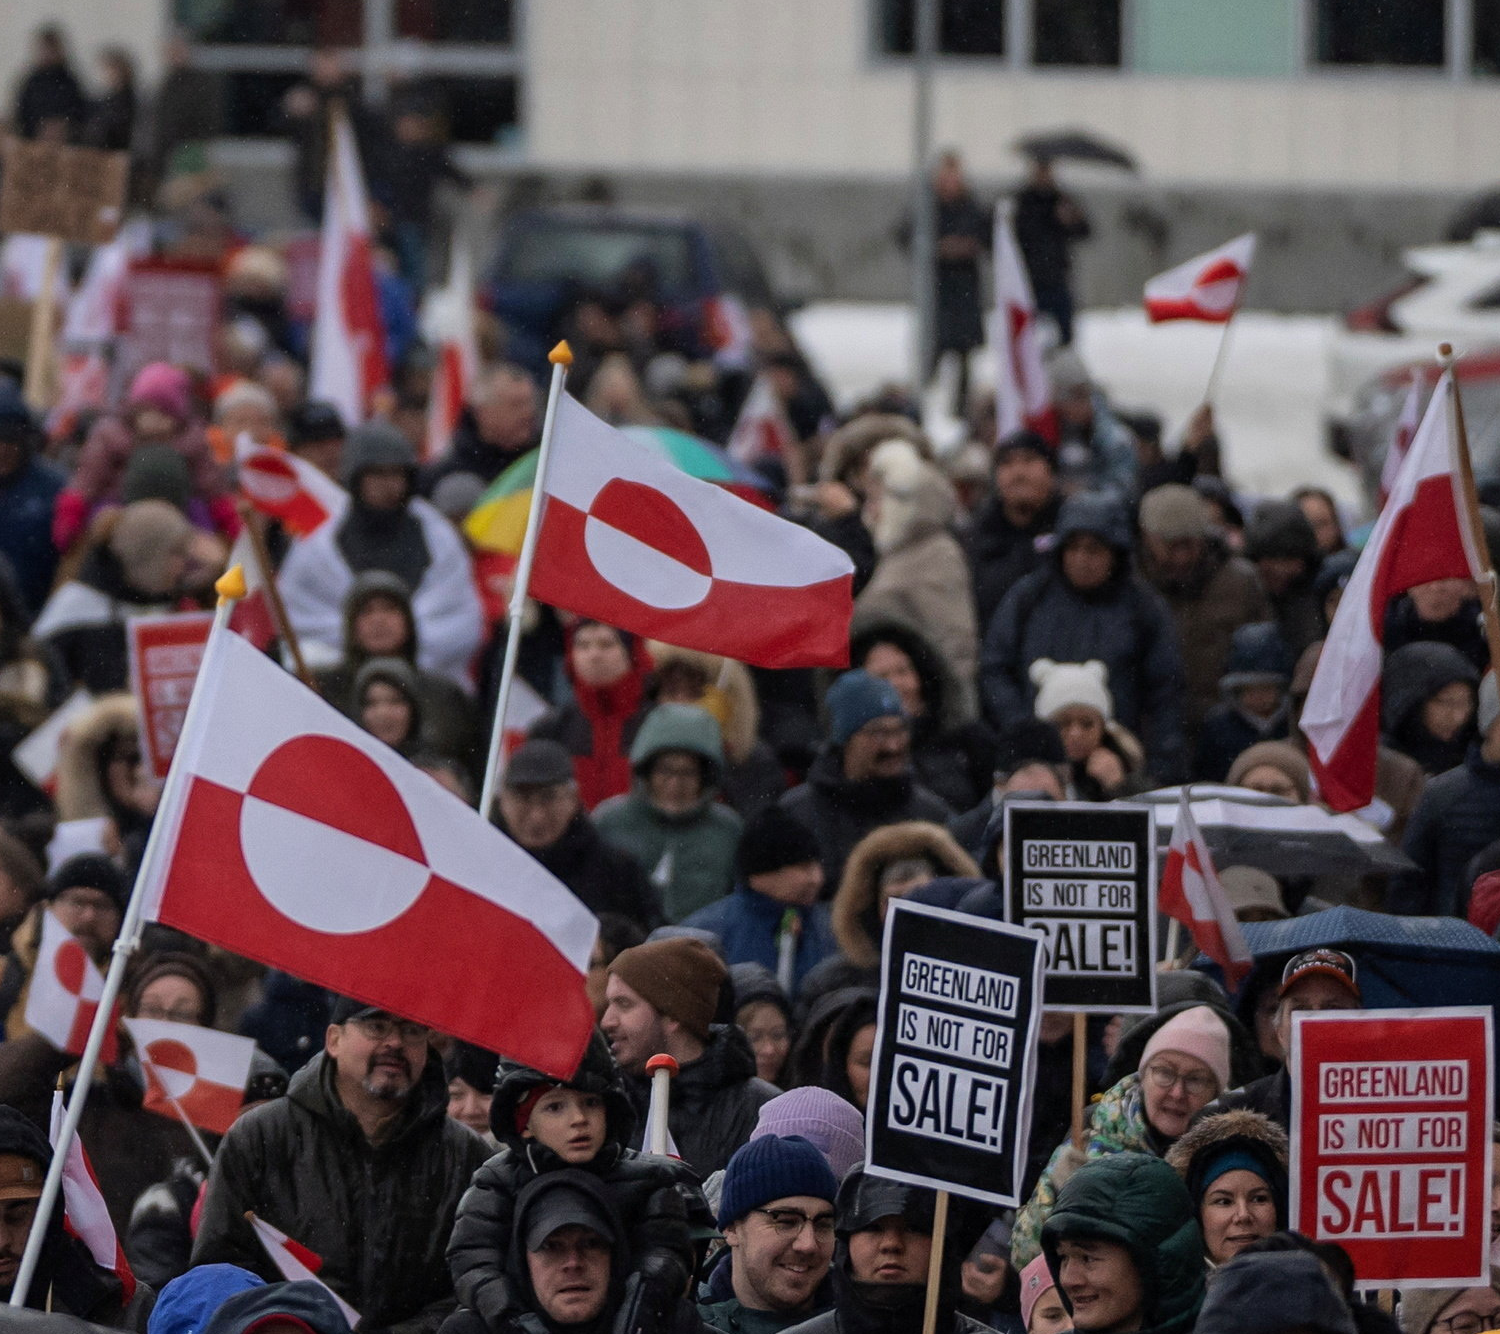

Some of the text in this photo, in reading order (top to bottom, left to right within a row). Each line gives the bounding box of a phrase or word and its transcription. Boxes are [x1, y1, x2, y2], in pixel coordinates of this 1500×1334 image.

[1027, 844, 1132, 869] GREENLAND
[1028, 882, 1131, 909] IS NOT FOR
[905, 958, 1015, 1011] GREENLAND
[900, 1009, 1009, 1063] IS NOT FOR
[1324, 1065, 1463, 1098] GREENLAND
[892, 1061, 1004, 1147] SALE!
[1323, 1116, 1462, 1150] IS NOT FOR
[1321, 1169, 1462, 1235] SALE!
